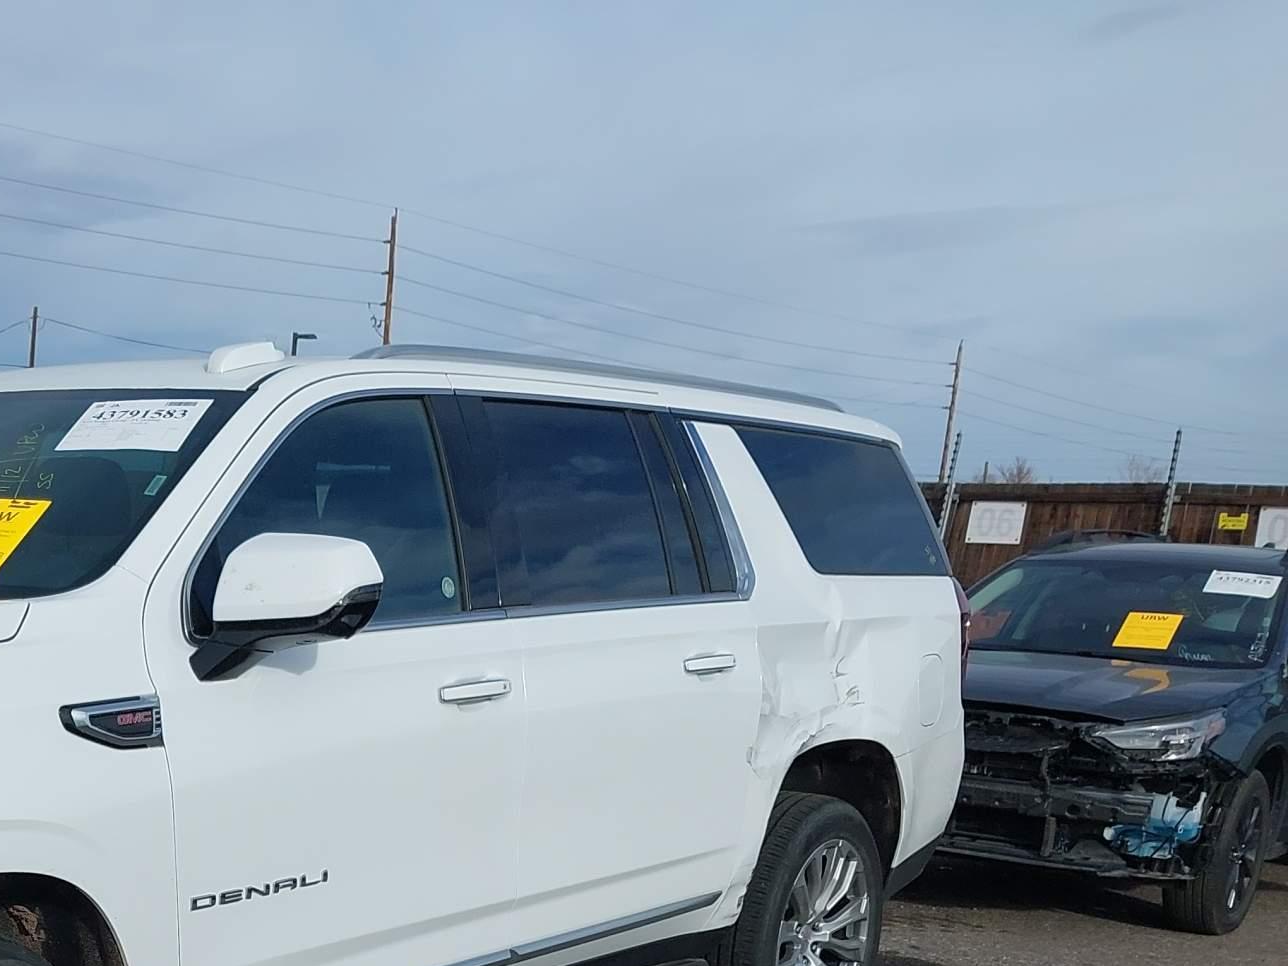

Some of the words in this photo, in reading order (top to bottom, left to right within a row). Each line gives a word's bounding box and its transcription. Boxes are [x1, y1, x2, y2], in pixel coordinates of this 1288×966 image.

[93, 408, 189, 421] 43791583
[117, 711, 152, 726] GMC
[190, 869, 328, 911] DENALI
